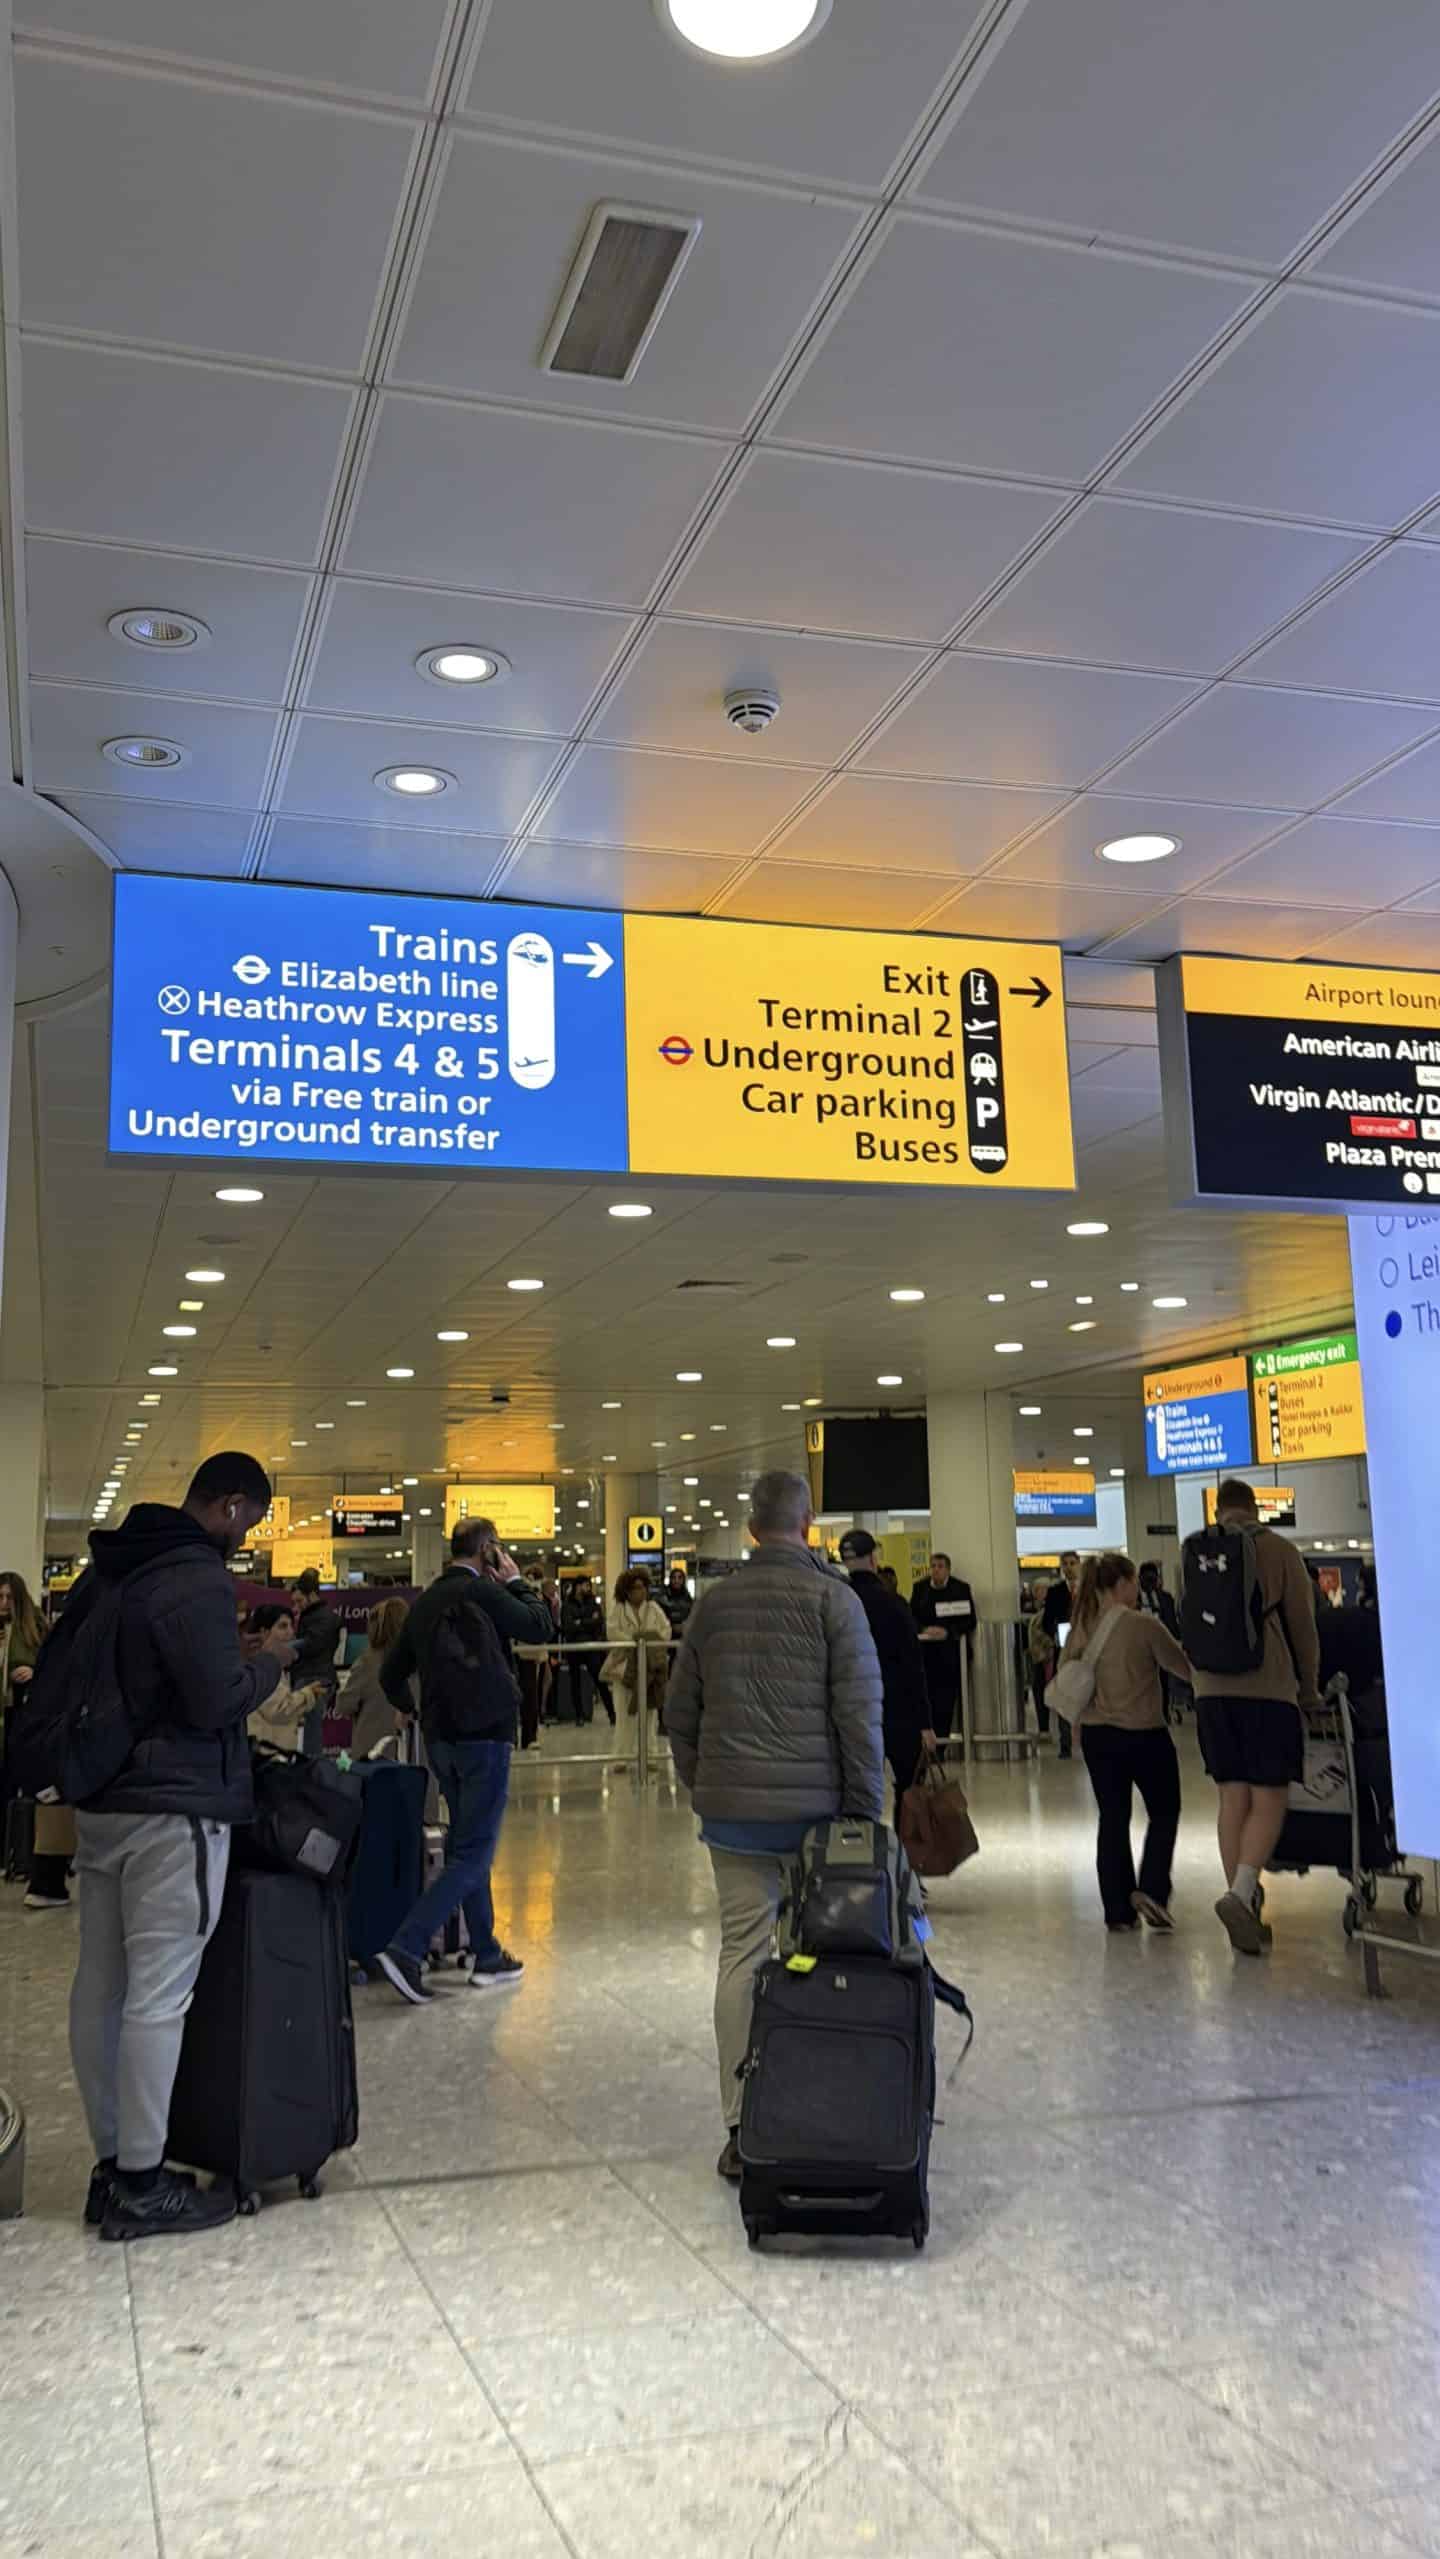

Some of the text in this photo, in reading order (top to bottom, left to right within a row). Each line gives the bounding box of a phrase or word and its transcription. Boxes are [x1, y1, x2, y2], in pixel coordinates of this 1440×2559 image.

[369, 925, 498, 965] Trains
[281, 963, 499, 1000] Elizabeth line
[883, 964, 950, 997] Exit
[1305, 983, 1440, 1010] Airport loun
[198, 991, 499, 1034] Heathrow Express
[758, 998, 953, 1038] Terminal 2
[161, 1029, 500, 1080] Terminals 4 & 5
[704, 1038, 955, 1081] Underground
[1283, 1033, 1391, 1060] American
[231, 1077, 492, 1116] via Free train or
[742, 1083, 956, 1128] Car parking
[1249, 1083, 1320, 1113] Virgin
[128, 1110, 500, 1151] Underground transfer
[855, 1131, 959, 1164] Buses
[1325, 1142, 1386, 1167] Plaza
[1277, 1343, 1346, 1369] Emergency exit
[1165, 1377, 1213, 1396] Underground
[1280, 1374, 1324, 1393] Terminal 2
[1165, 1403, 1187, 1418] Trains
[1280, 1397, 1304, 1409] Buses
[1282, 1422, 1332, 1439] Car parking
[1282, 1441, 1304, 1453] Taxis
